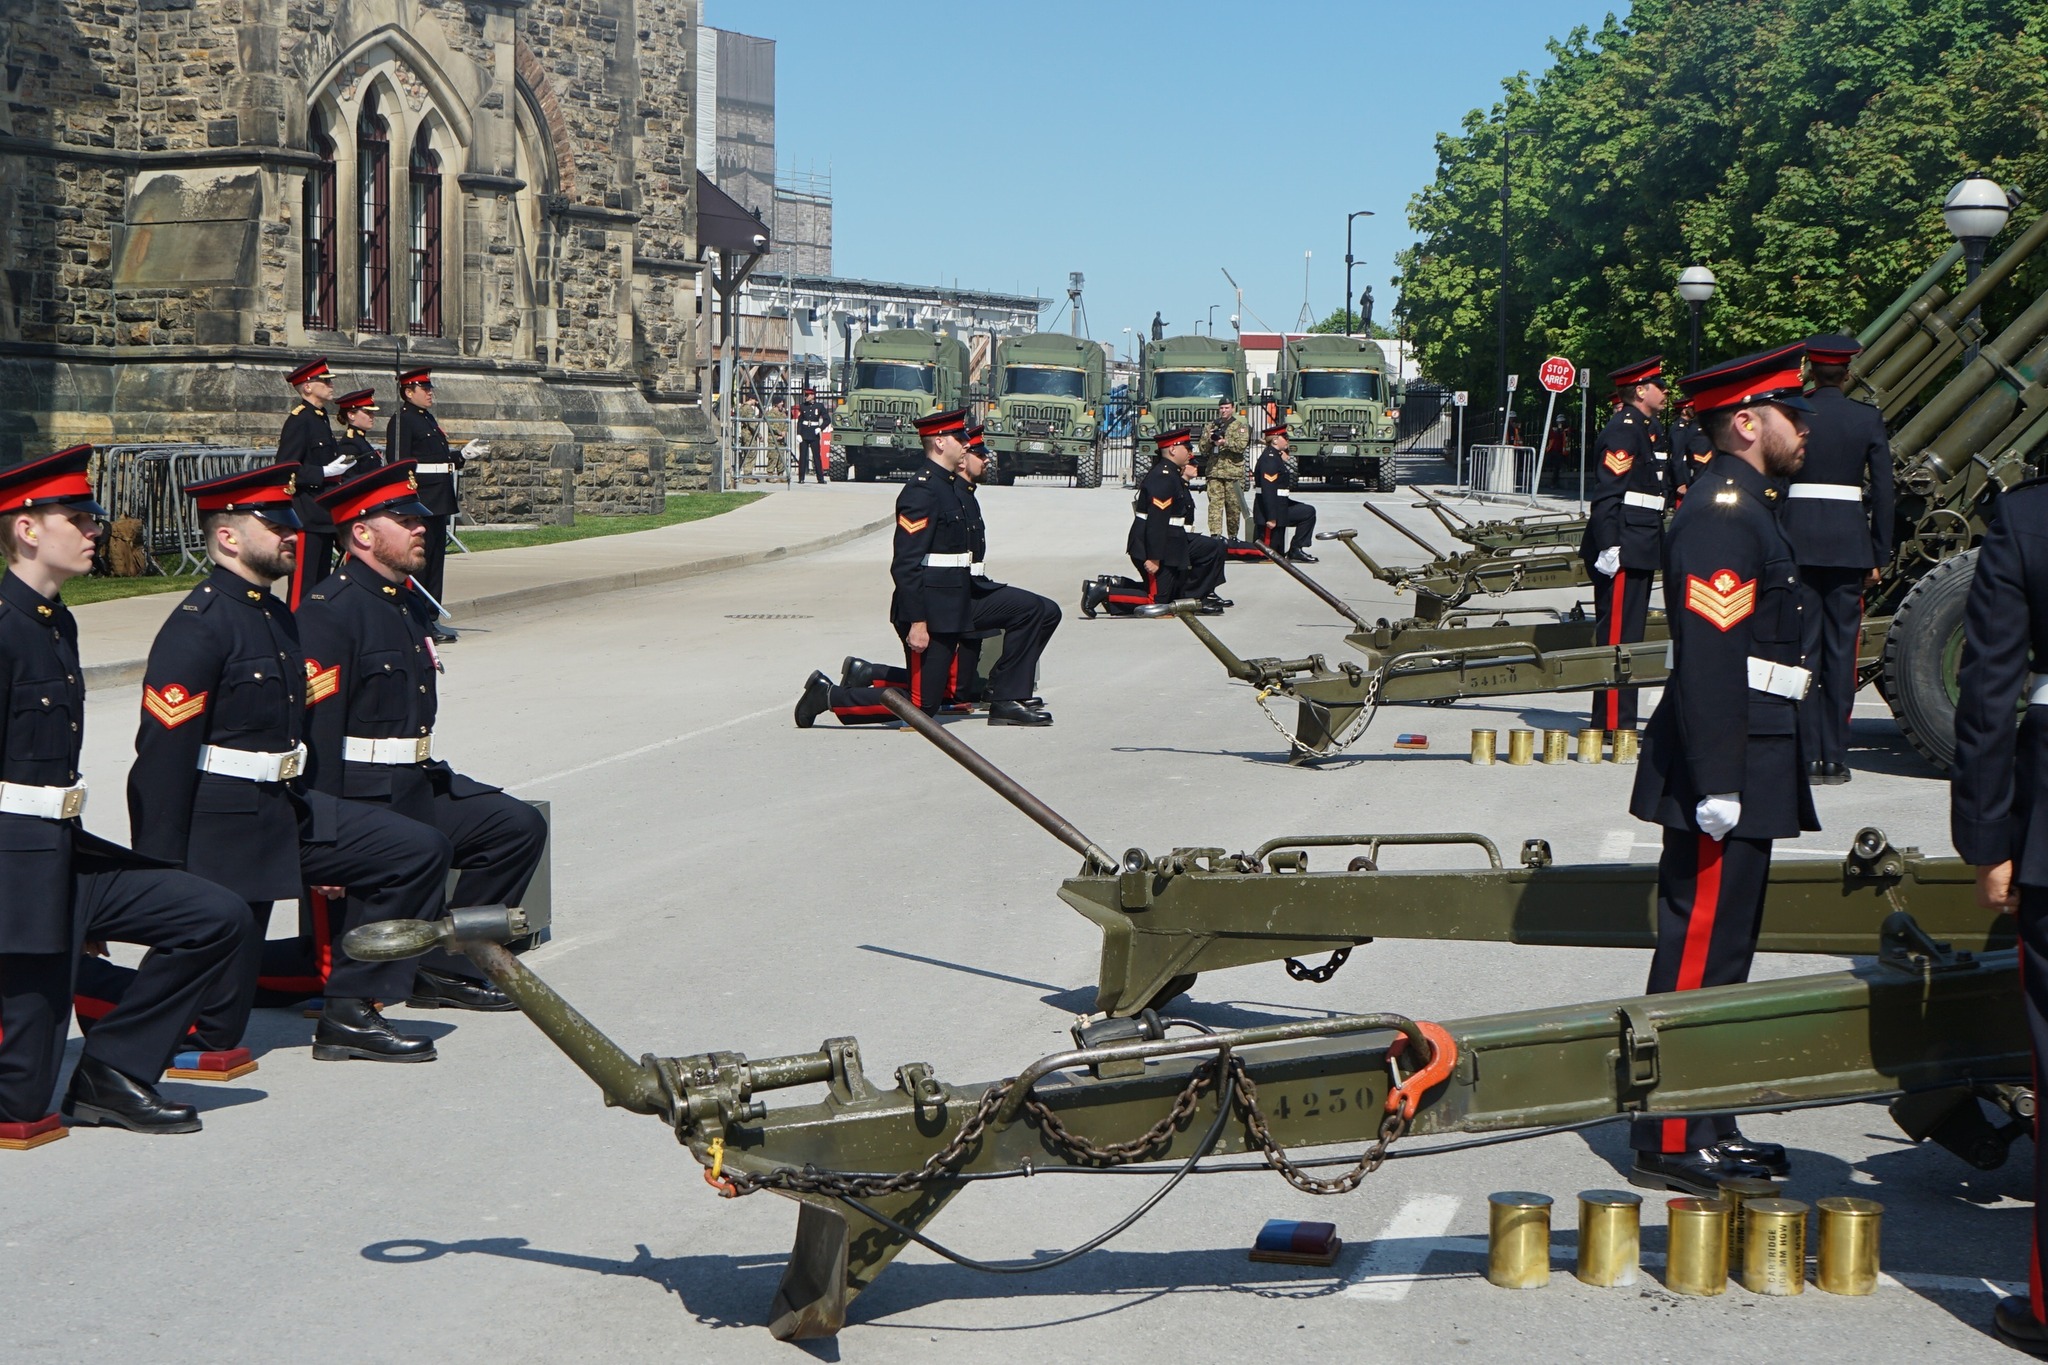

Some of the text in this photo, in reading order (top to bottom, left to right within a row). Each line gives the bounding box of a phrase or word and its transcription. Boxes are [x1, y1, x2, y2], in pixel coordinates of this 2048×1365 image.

[1547, 364, 1569, 375] STOP
[1779, 1224, 1788, 1246] HOW
[1767, 1229, 1777, 1283] CARTRIDGE
[1779, 1250, 1788, 1267] MM
